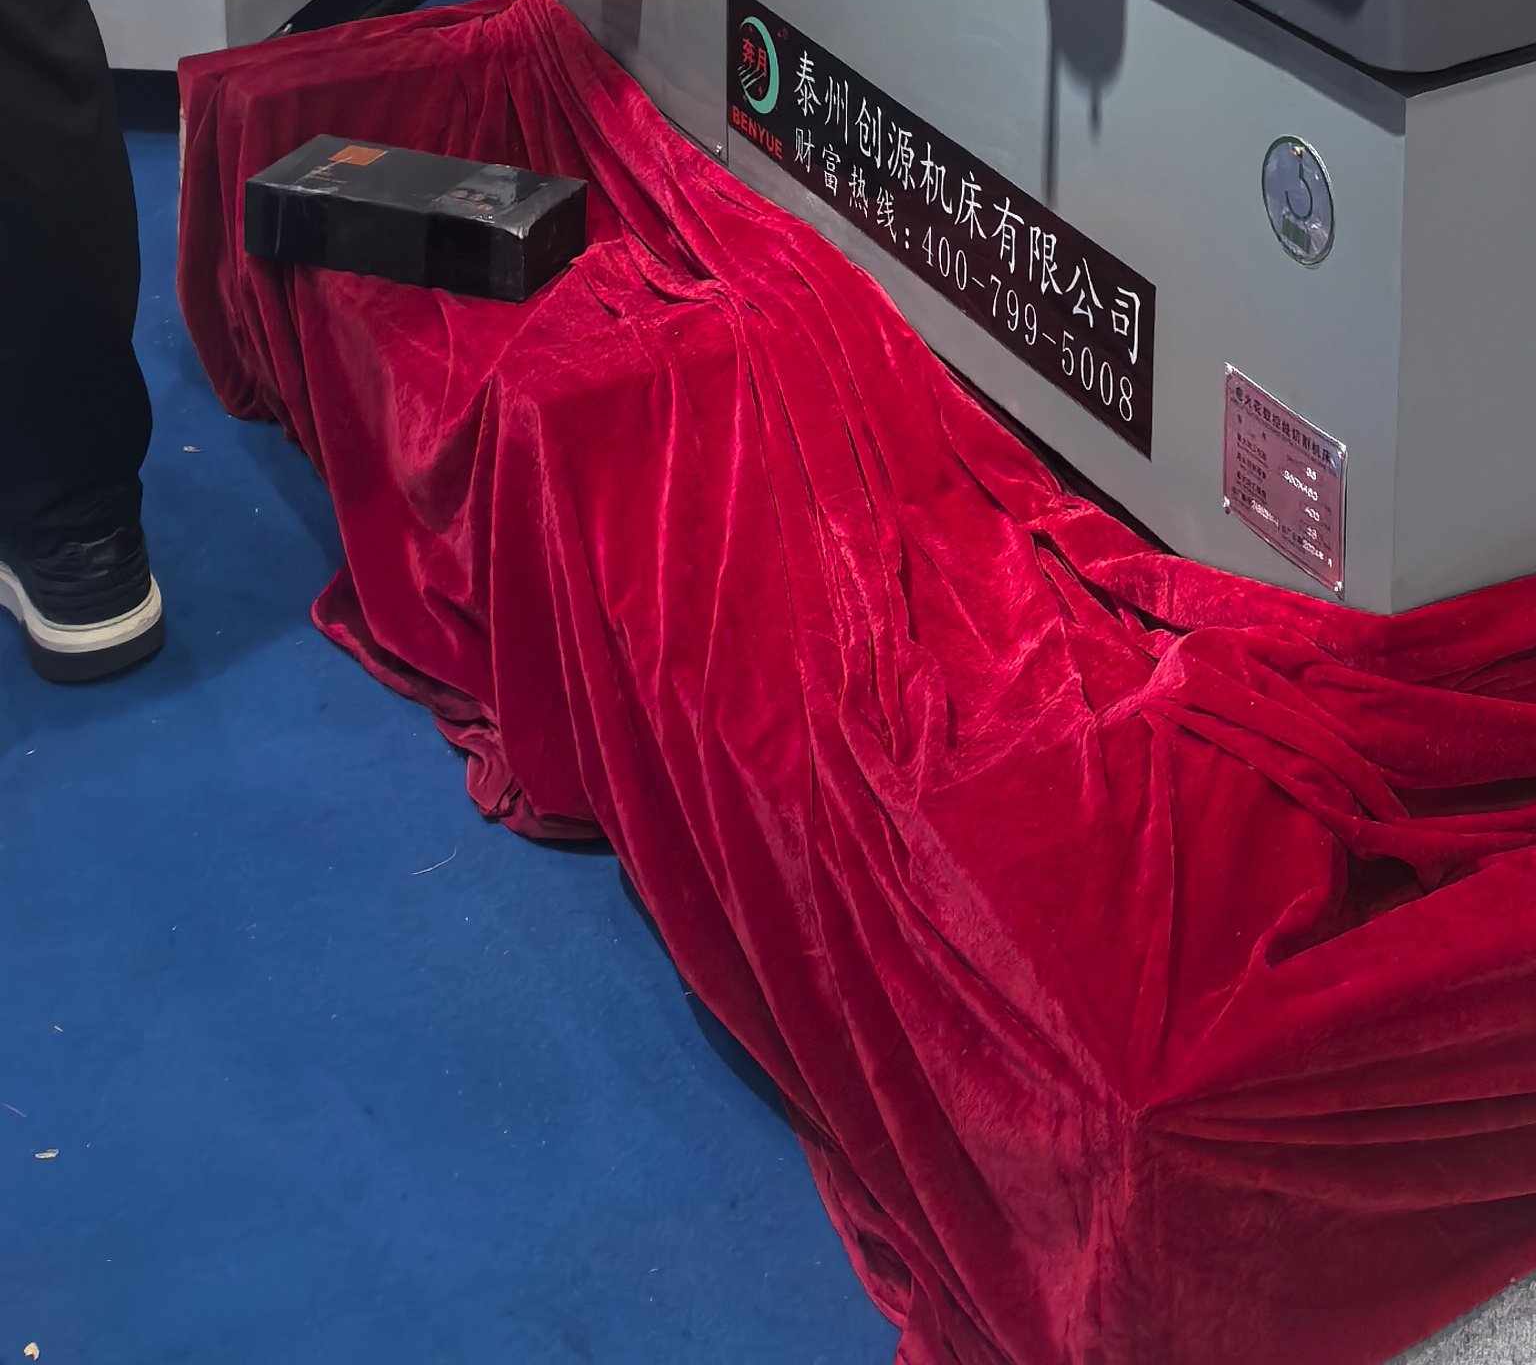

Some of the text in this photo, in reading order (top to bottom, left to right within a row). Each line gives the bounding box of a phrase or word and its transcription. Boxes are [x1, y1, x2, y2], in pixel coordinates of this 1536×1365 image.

[731, 104, 783, 161] BENYUE
[794, 50, 1141, 366] 泰州创源机床有限公司
